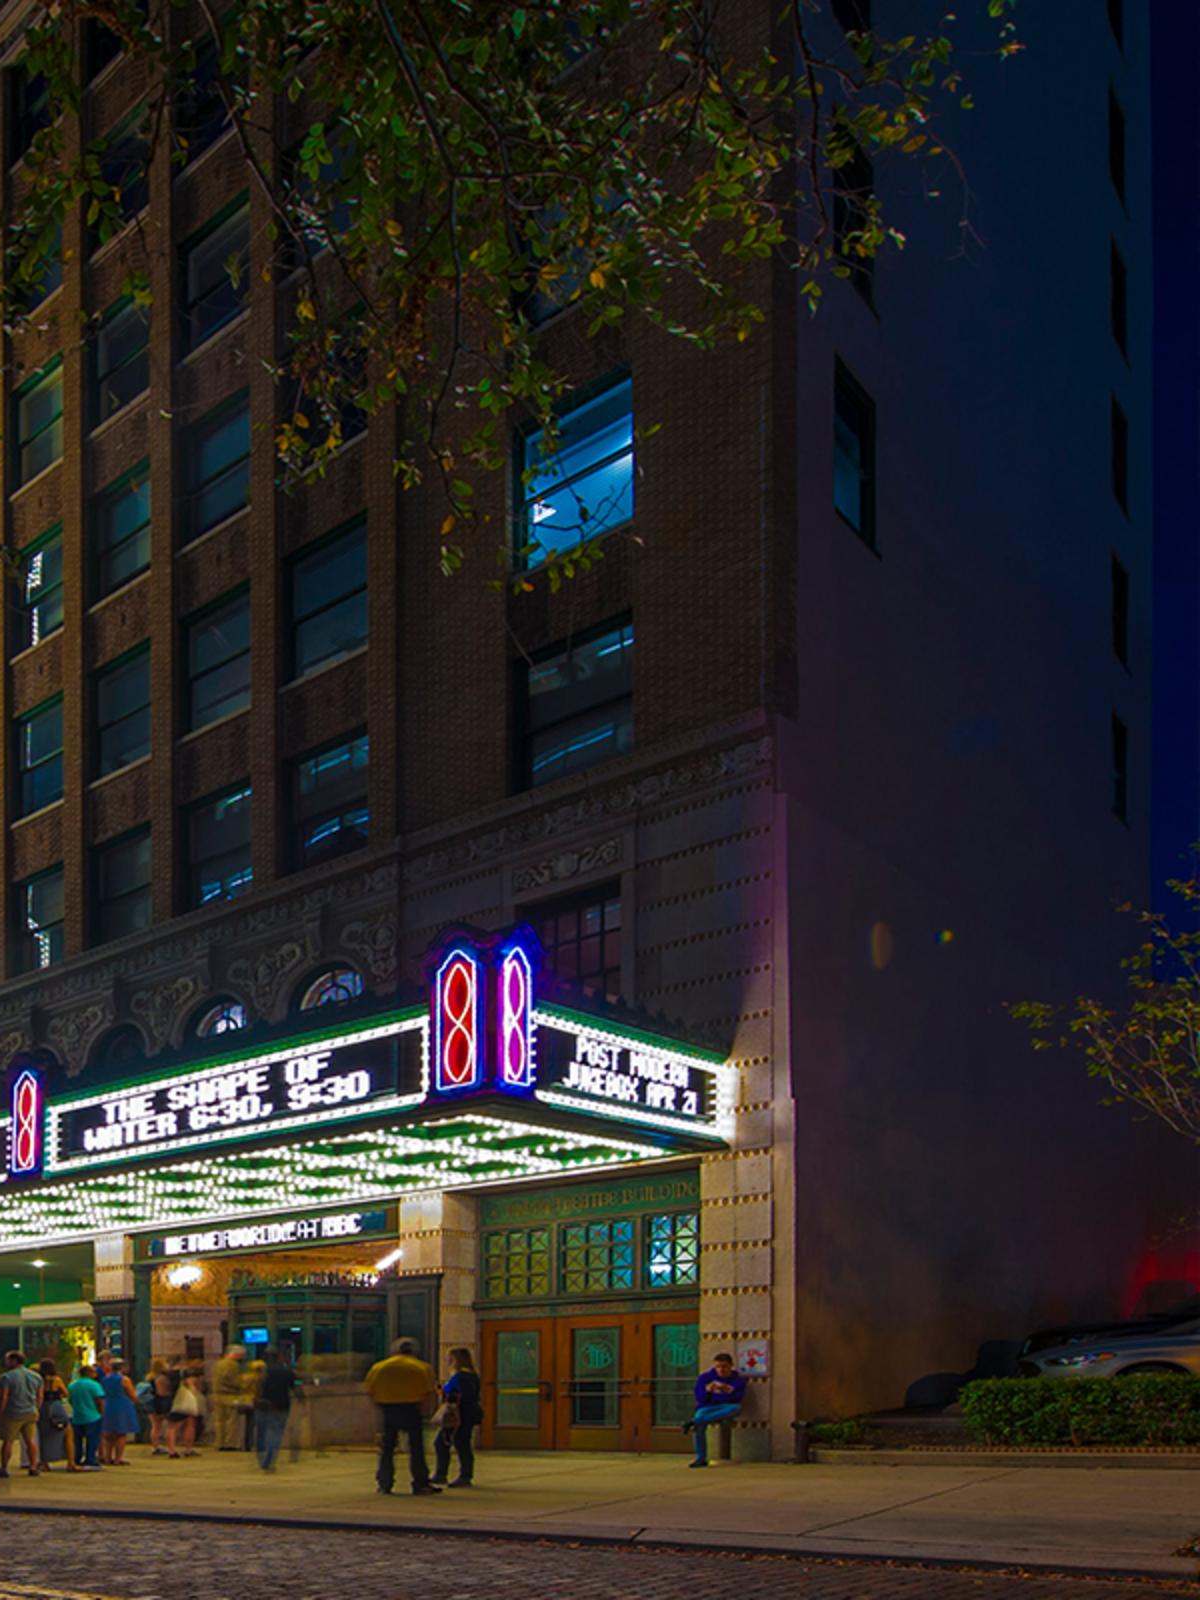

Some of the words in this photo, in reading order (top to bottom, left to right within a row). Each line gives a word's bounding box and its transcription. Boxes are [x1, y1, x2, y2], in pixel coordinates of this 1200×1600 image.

[102, 1092, 156, 1124] THE
[167, 1065, 271, 1111] SHAPE
[284, 1051, 333, 1085] OF
[562, 1061, 639, 1103] JUKEBOX
[645, 1081, 677, 1112] APR
[576, 1036, 622, 1071] POST
[629, 1050, 690, 1089] MODERN
[83, 1112, 178, 1151] WATER
[288, 1070, 371, 1111] 9:30
